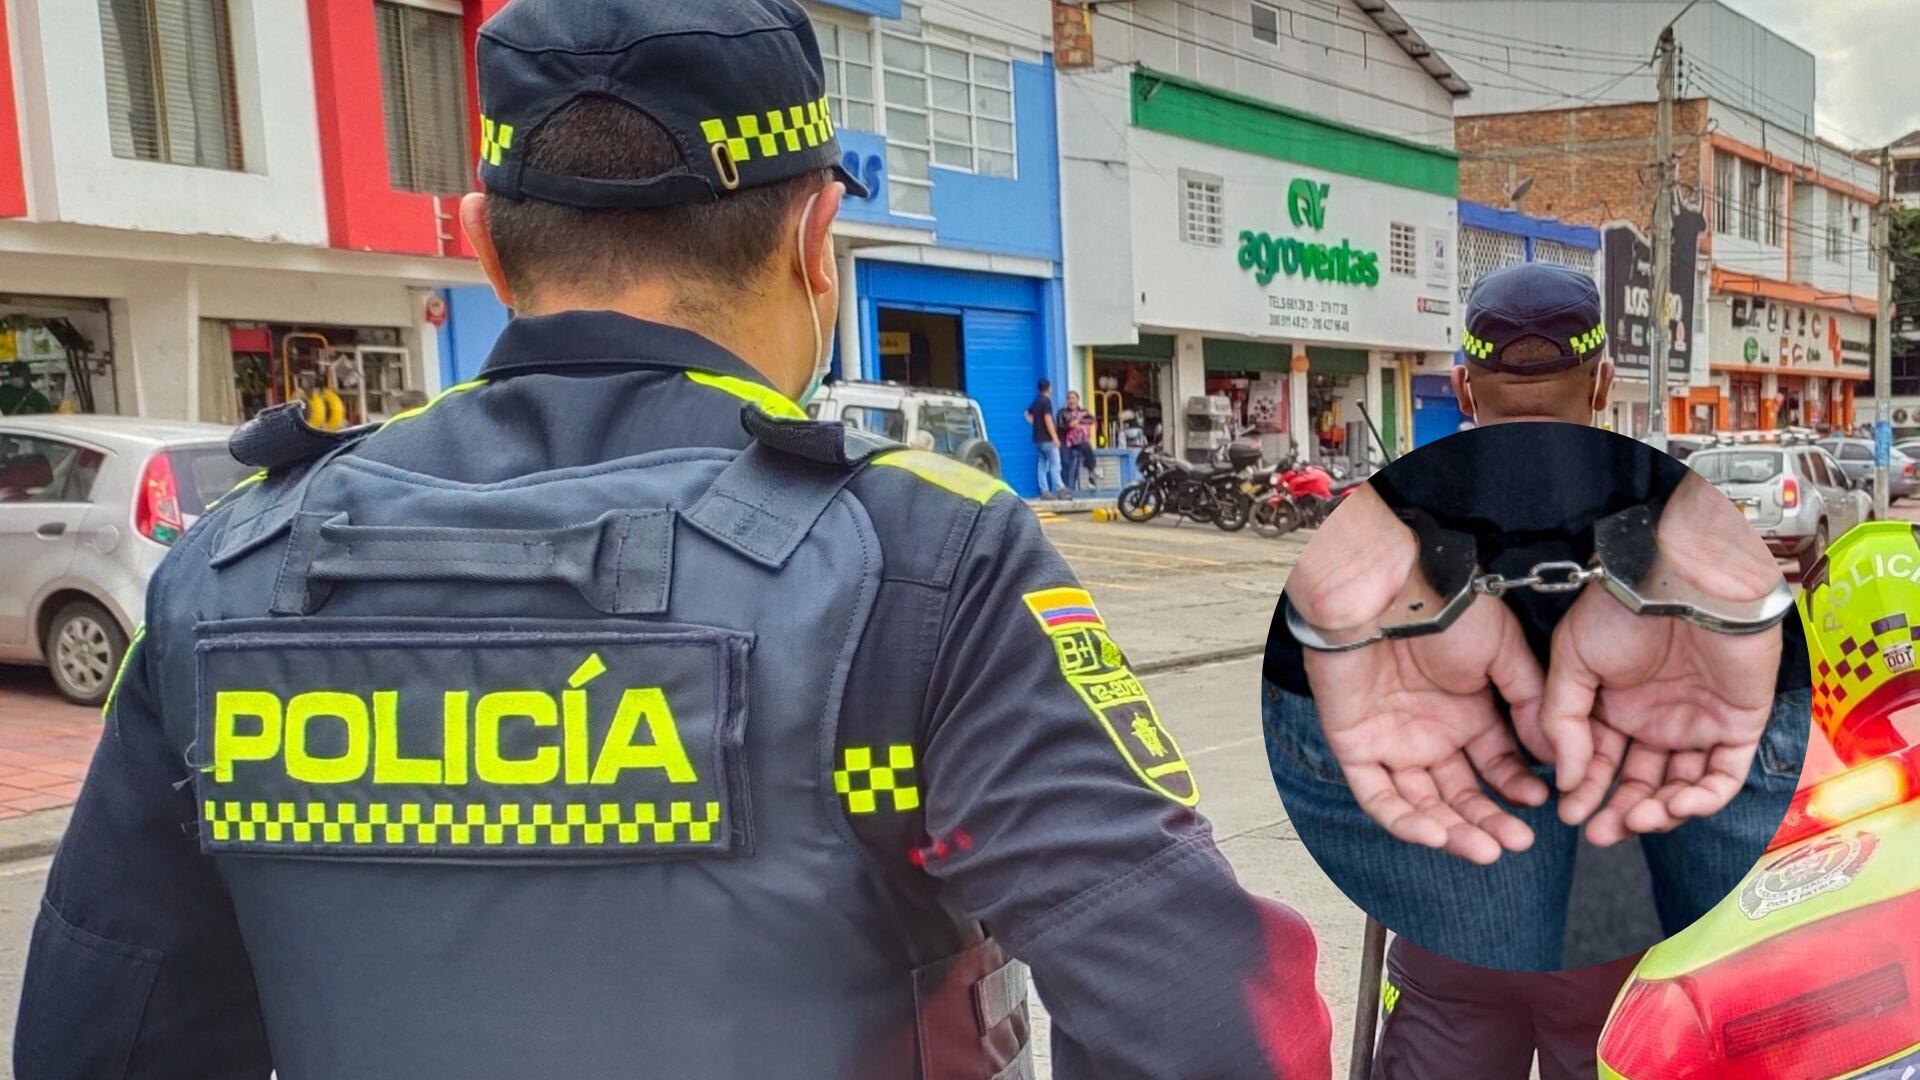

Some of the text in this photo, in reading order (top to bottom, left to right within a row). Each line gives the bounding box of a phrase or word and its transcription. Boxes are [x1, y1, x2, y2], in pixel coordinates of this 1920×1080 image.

[1238, 230, 1379, 287] agroventas
[1624, 284, 1649, 318] LOS
[1822, 553, 1920, 632] POLIC
[1059, 636, 1090, 669] B+
[215, 652, 698, 785] POLICÍA
